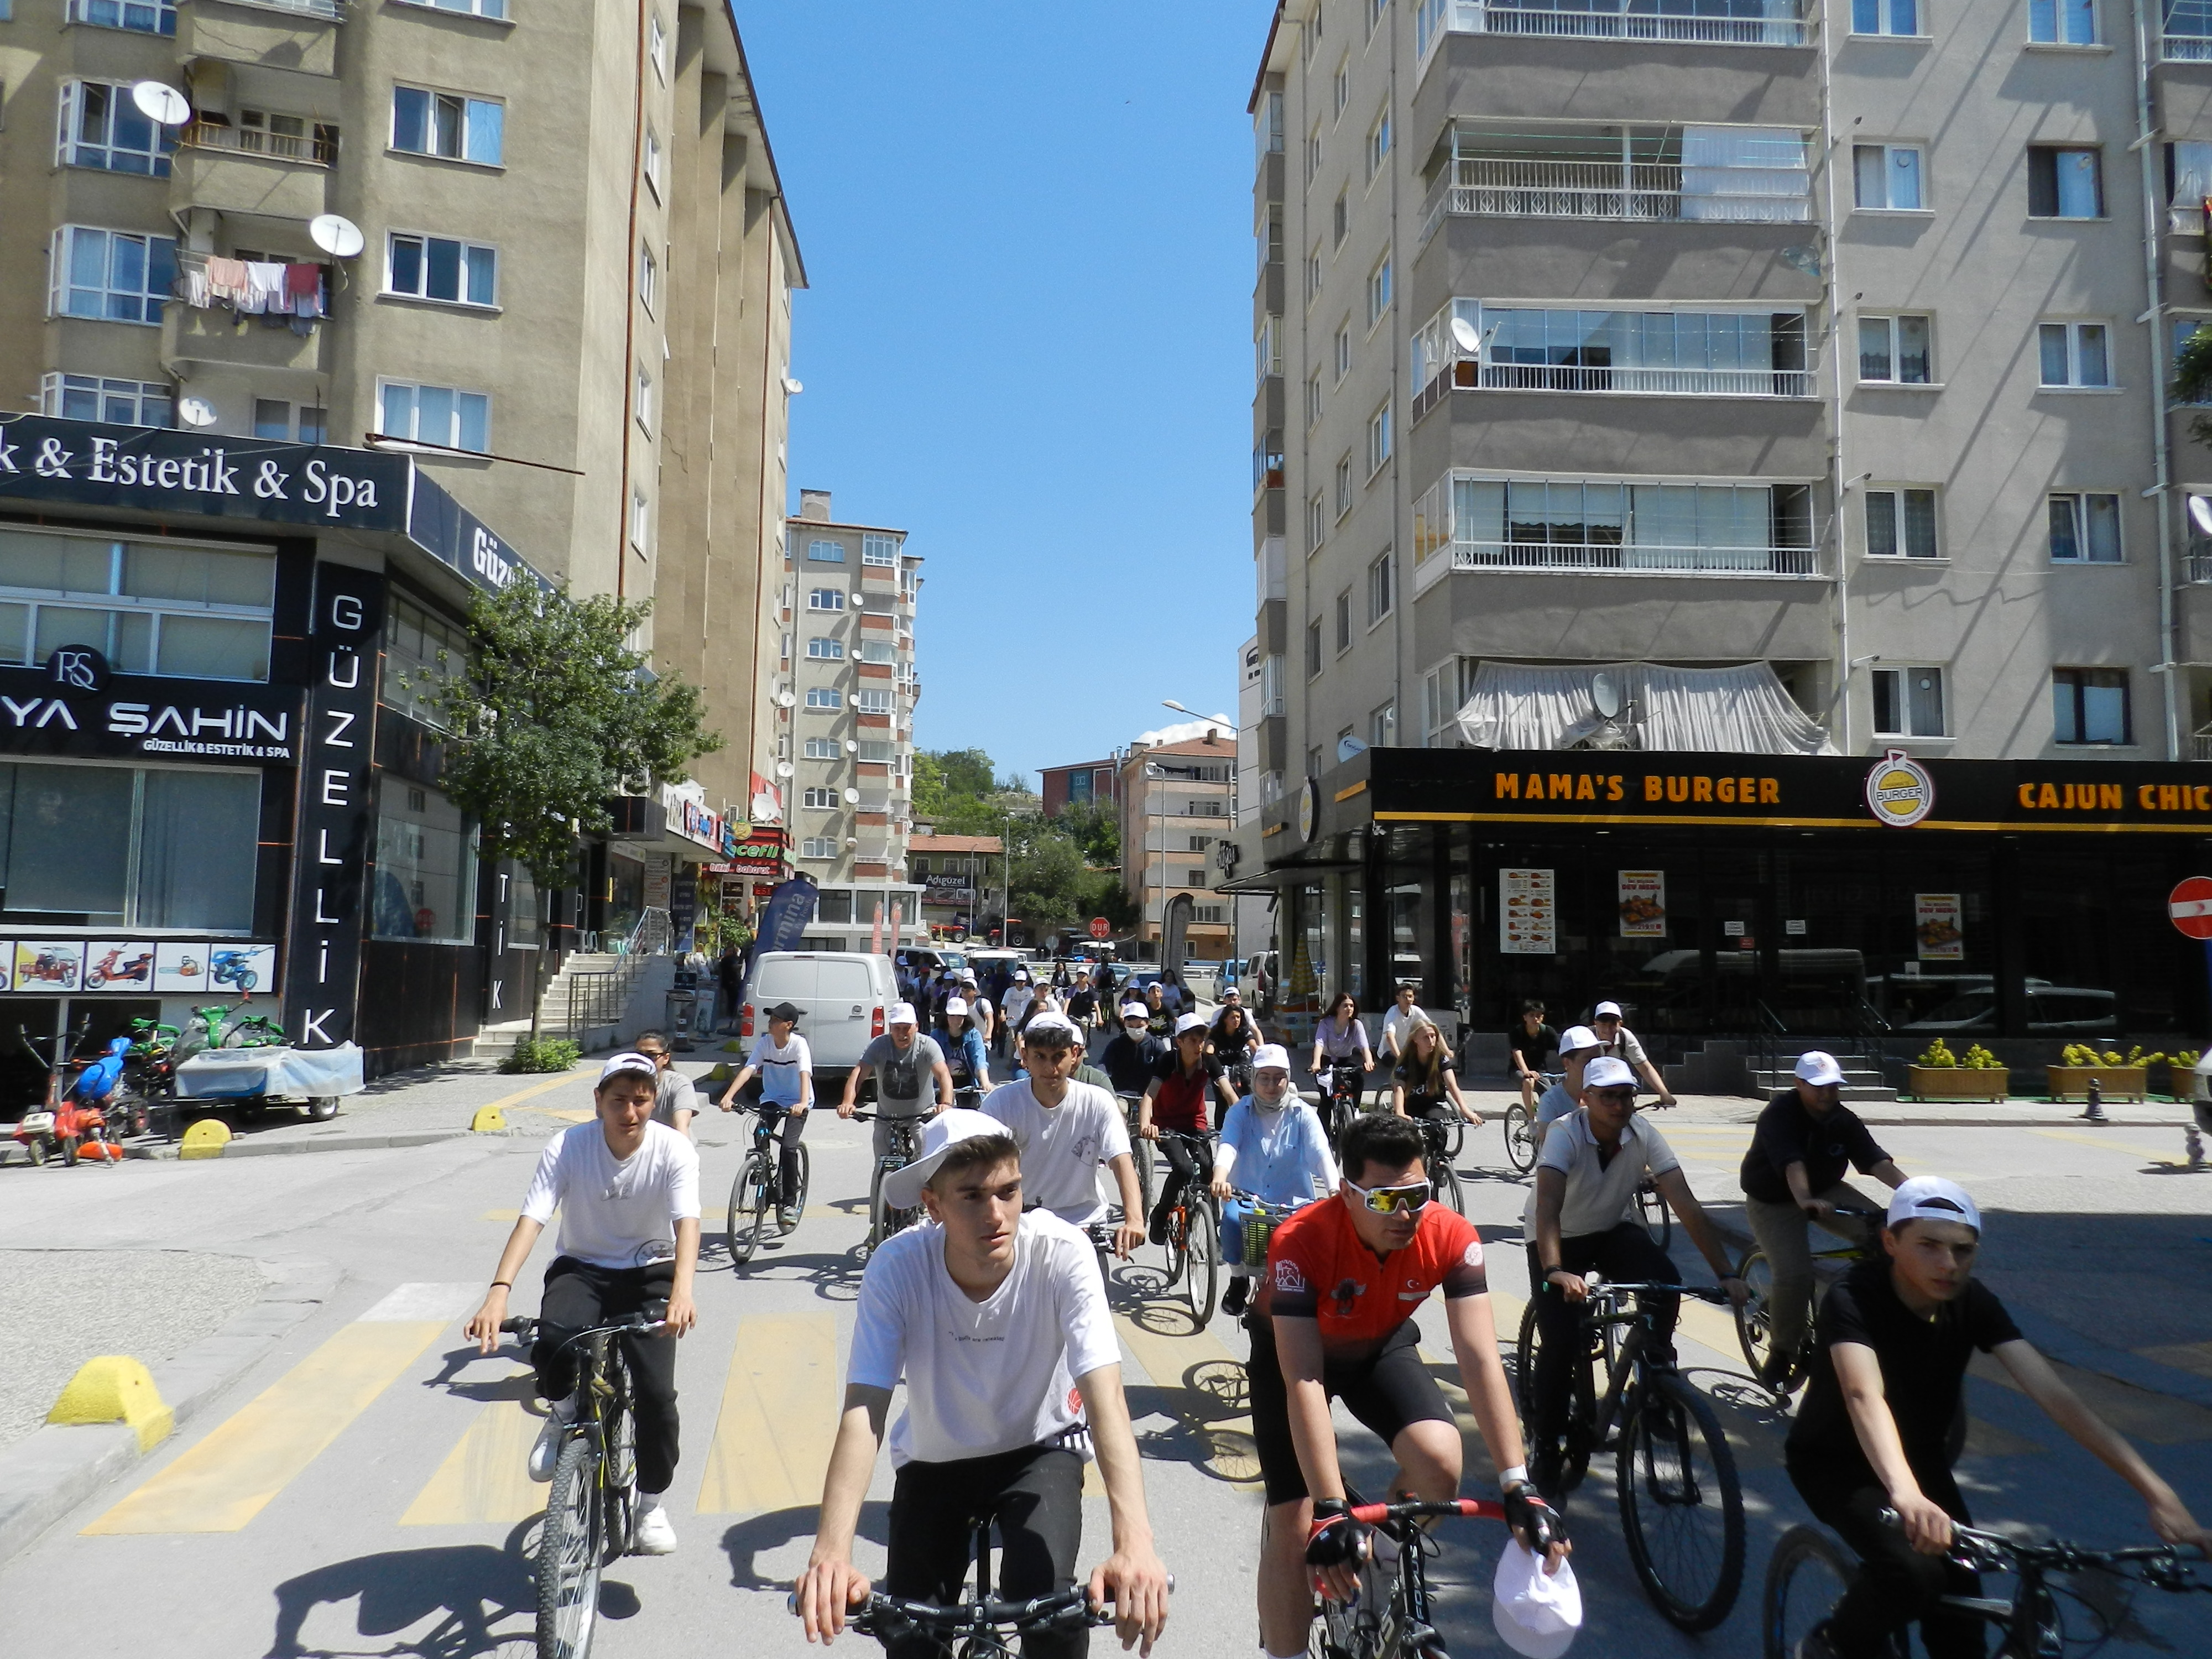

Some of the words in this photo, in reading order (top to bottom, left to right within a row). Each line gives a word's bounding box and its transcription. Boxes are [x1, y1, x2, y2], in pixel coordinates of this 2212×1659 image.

[35, 437, 74, 479] &
[87, 435, 241, 496] Estetik
[253, 459, 290, 500] &
[303, 458, 379, 518] Spa
[108, 702, 288, 741] ŞAHİN
[266, 747, 290, 758] SPA
[1496, 773, 1624, 801] MAMA'S
[1645, 775, 1781, 804] BURGER
[1876, 787, 1923, 801] BURGER
[2018, 782, 2122, 810] CAJUN
[772, 893, 805, 951] rmina
[1092, 923, 1108, 931] DUR
[1410, 1544, 1425, 1620] FOUS
